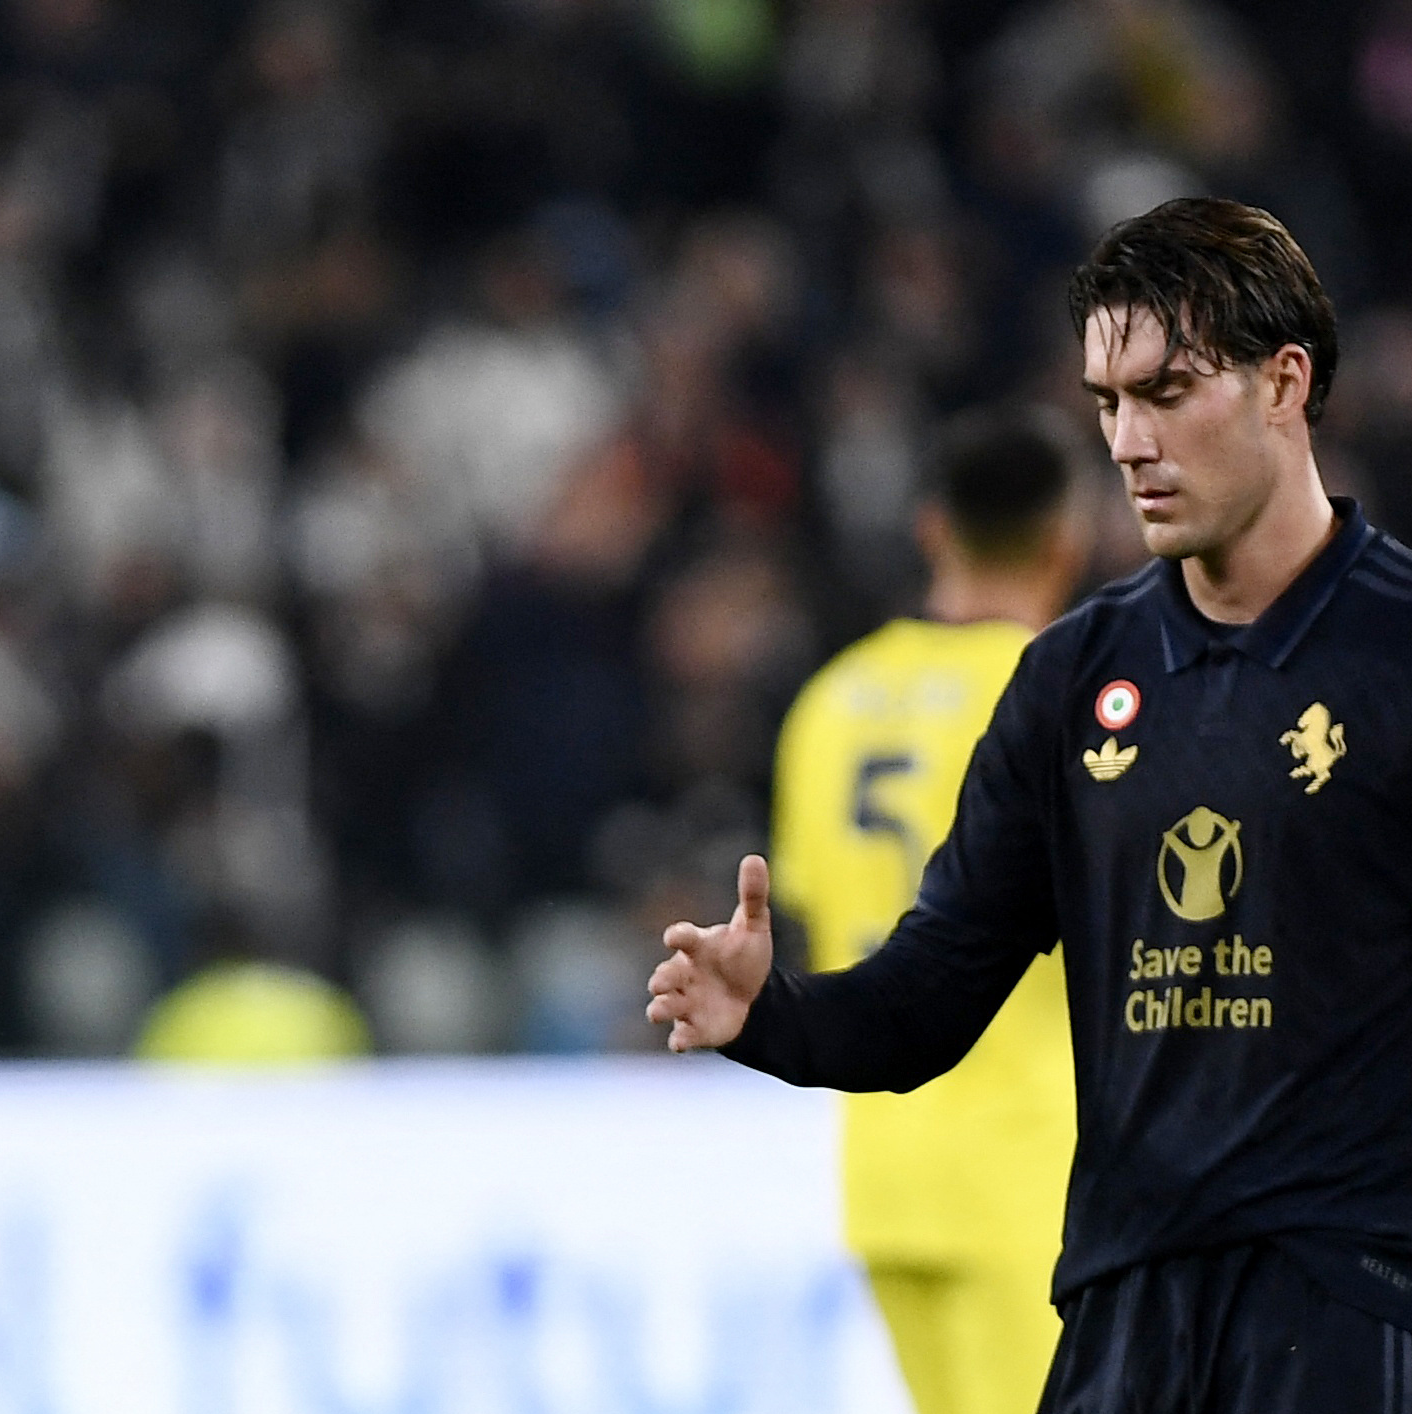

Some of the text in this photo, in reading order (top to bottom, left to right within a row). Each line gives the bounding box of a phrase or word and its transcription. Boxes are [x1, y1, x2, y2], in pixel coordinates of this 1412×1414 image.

[1129, 934, 1273, 981] Save the
[1125, 986, 1273, 1033] Children
